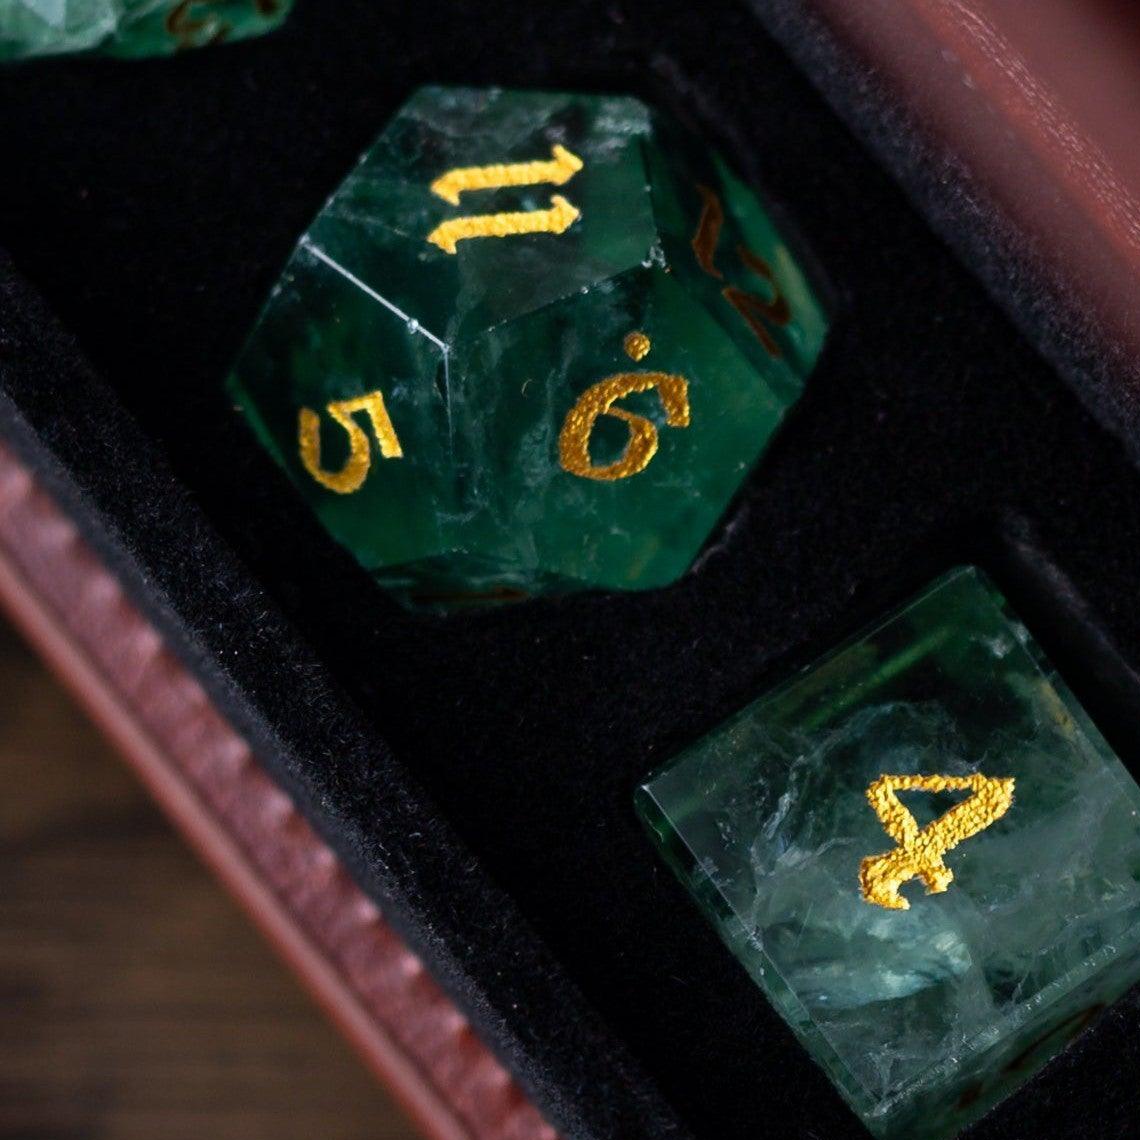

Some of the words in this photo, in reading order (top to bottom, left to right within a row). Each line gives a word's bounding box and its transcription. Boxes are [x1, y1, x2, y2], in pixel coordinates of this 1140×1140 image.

[429, 146, 583, 254] 11
[299, 391, 402, 495] 5
[859, 773, 1015, 911] 4
